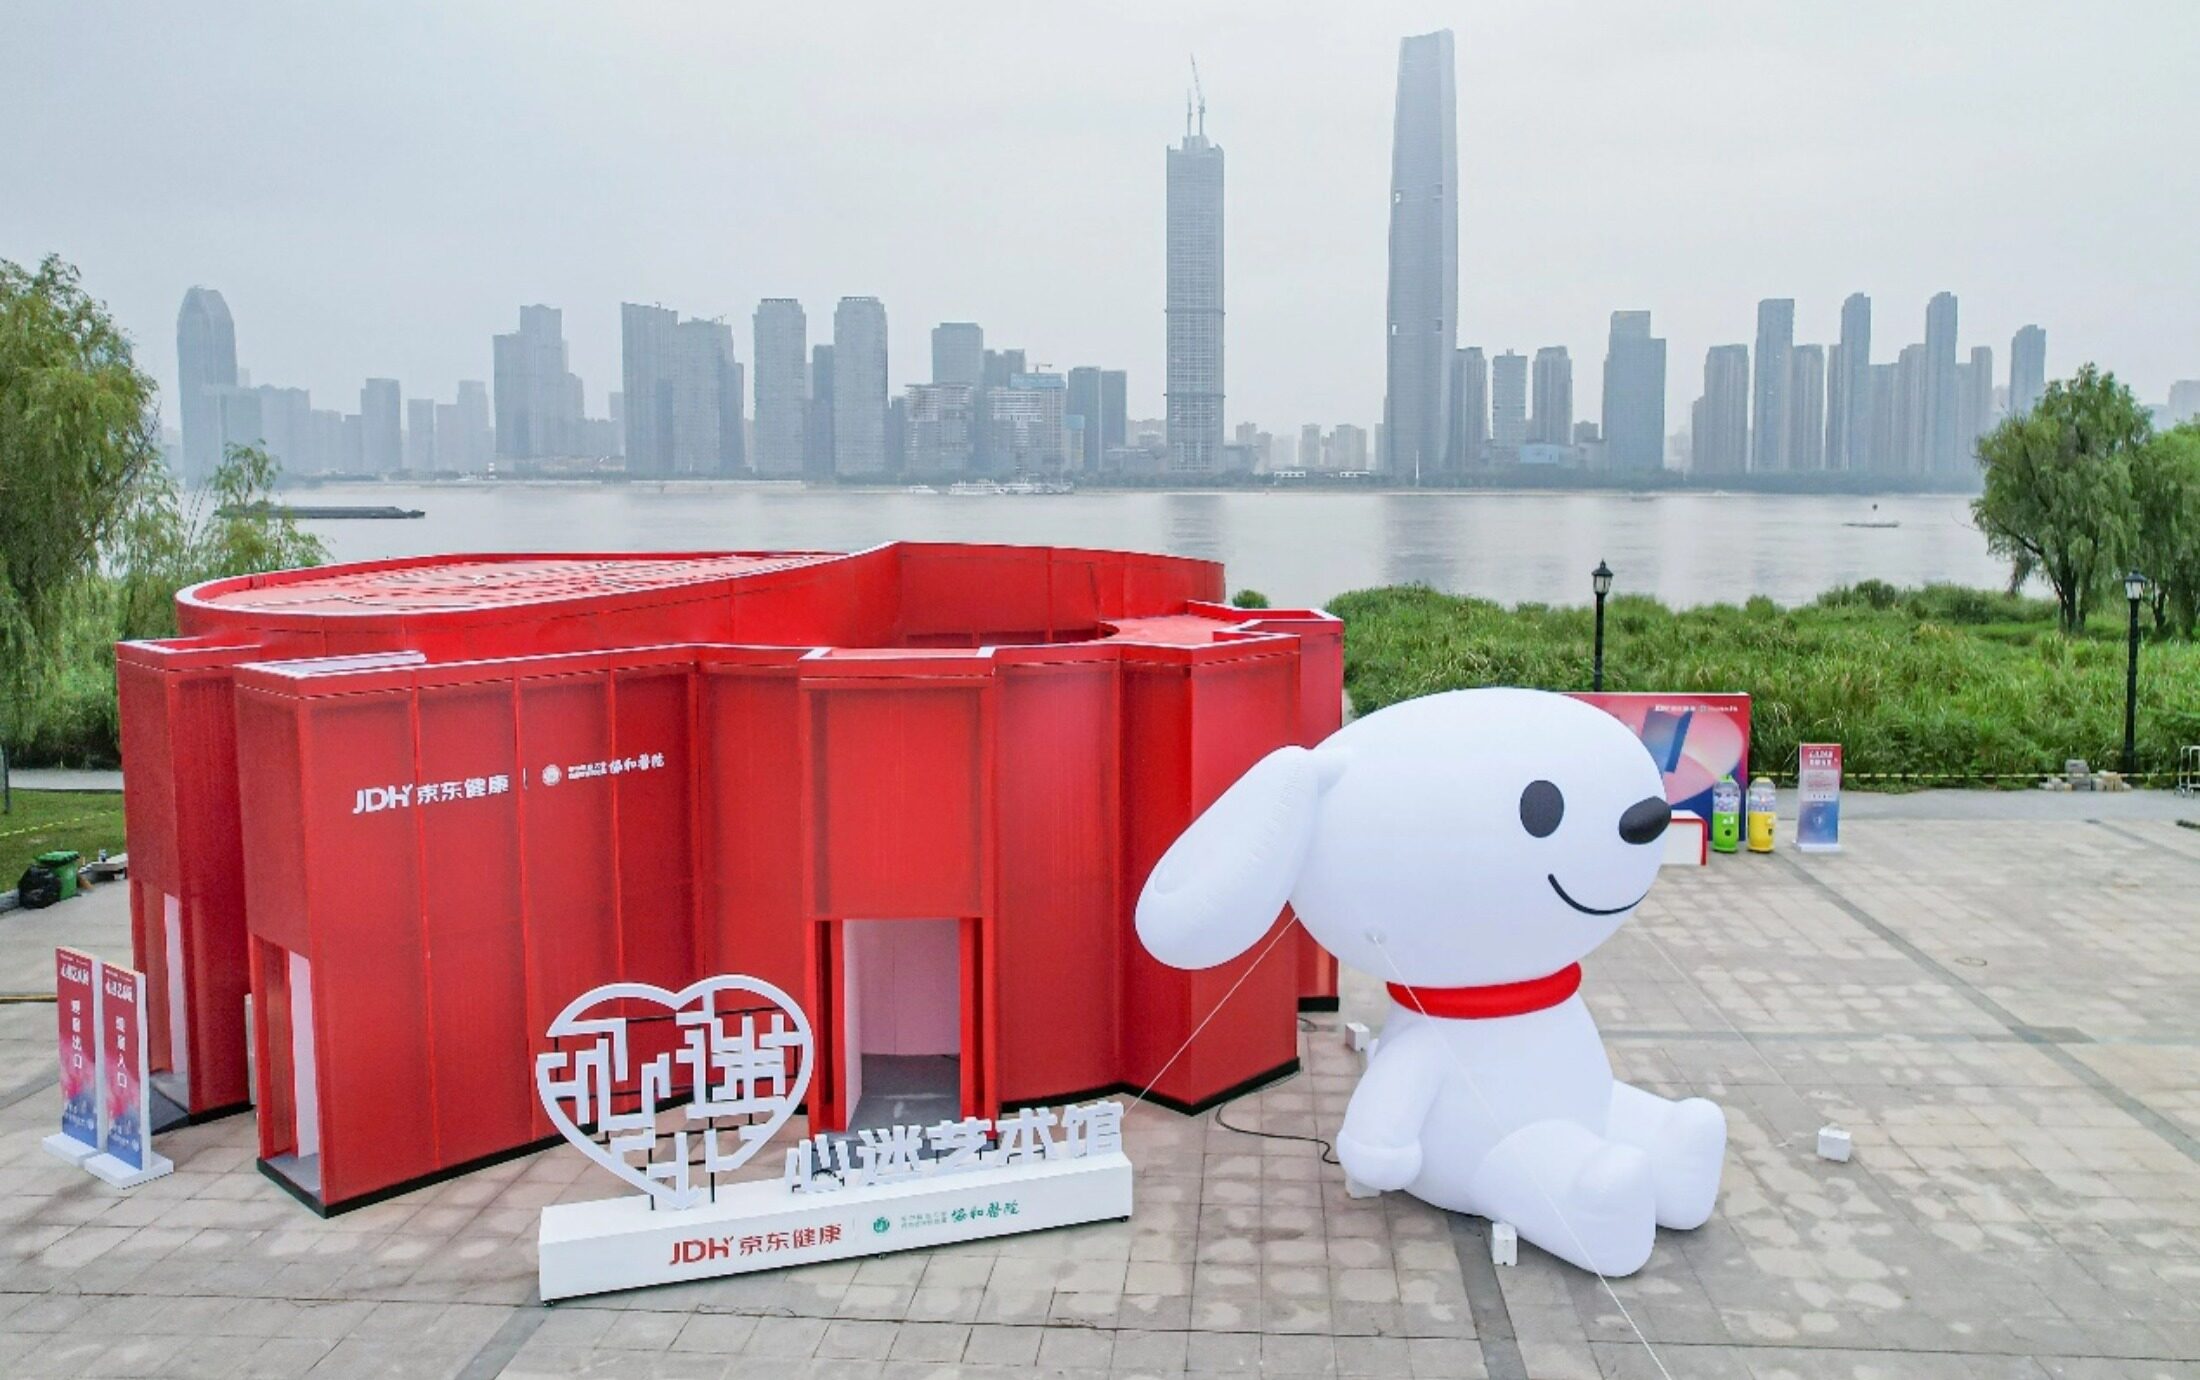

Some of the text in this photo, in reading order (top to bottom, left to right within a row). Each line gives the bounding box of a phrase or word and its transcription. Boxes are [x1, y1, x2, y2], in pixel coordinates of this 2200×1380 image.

[416, 774, 509, 806] 京东健康
[71, 999, 83, 1070] 出口
[115, 1014, 128, 1089] 入口
[784, 1100, 1124, 1194] 心迷艺术馆
[738, 1223, 842, 1257] 京东健康
